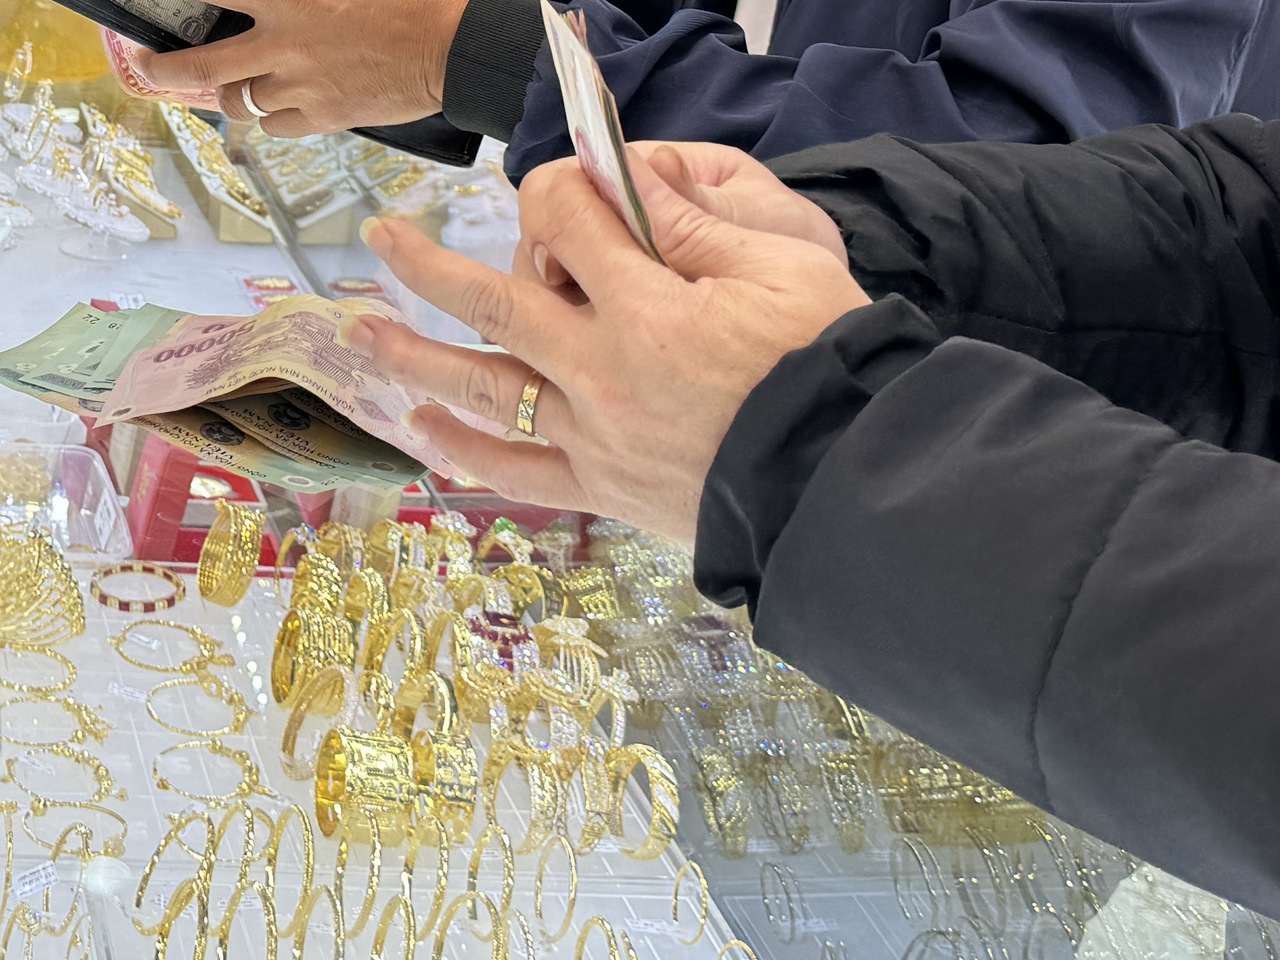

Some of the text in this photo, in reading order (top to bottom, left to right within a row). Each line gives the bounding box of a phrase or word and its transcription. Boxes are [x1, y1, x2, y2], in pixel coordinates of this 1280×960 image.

[153, 320, 256, 363] 50000
[242, 407, 273, 428] NAM
[172, 424, 202, 443] NAM
